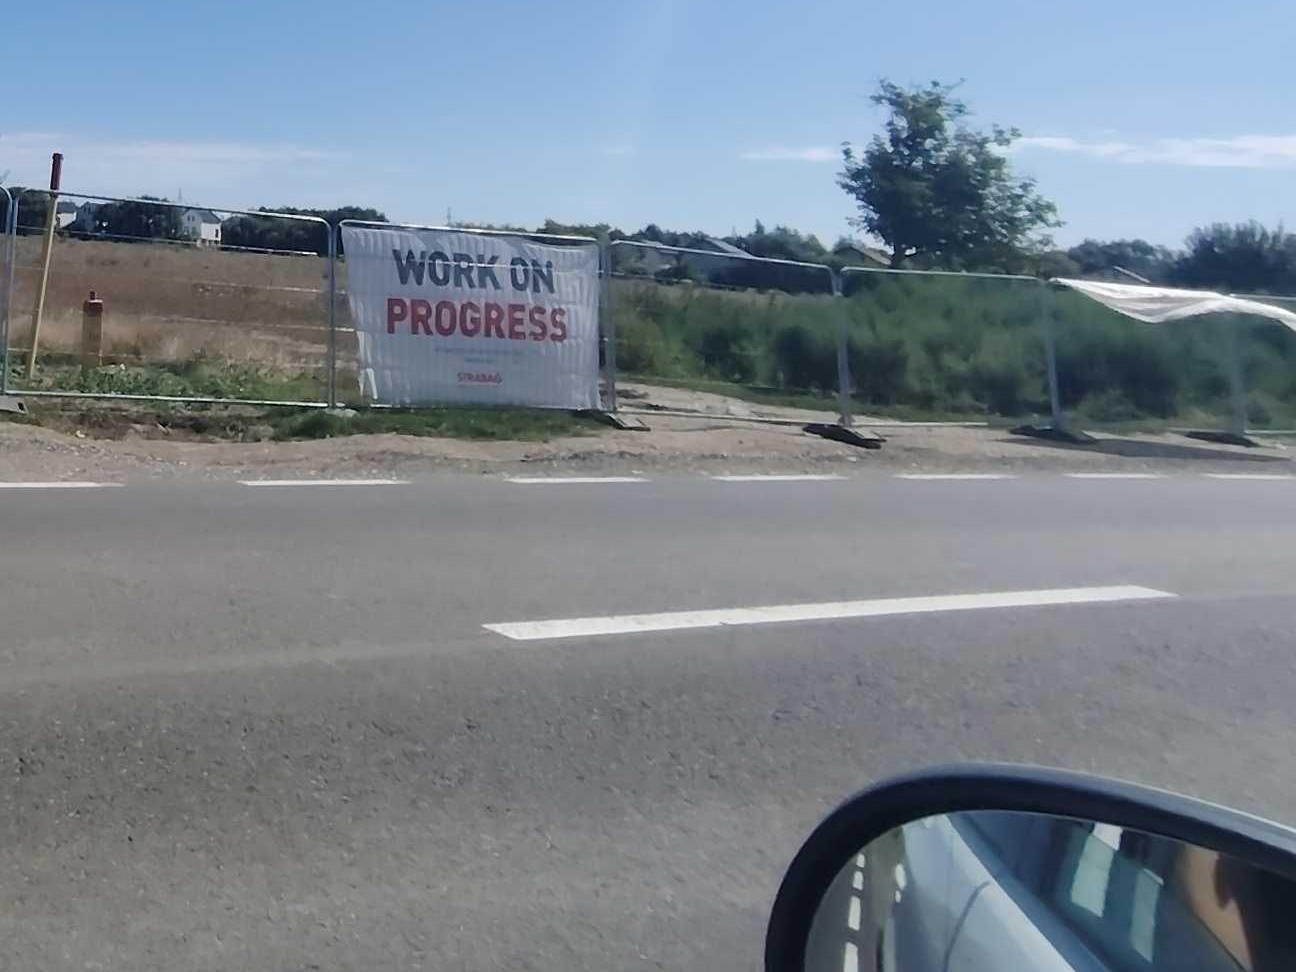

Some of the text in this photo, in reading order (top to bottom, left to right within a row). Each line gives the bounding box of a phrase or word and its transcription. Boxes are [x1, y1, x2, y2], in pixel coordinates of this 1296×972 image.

[391, 248, 556, 294] WORK ON
[386, 297, 568, 343] PROGRESS
